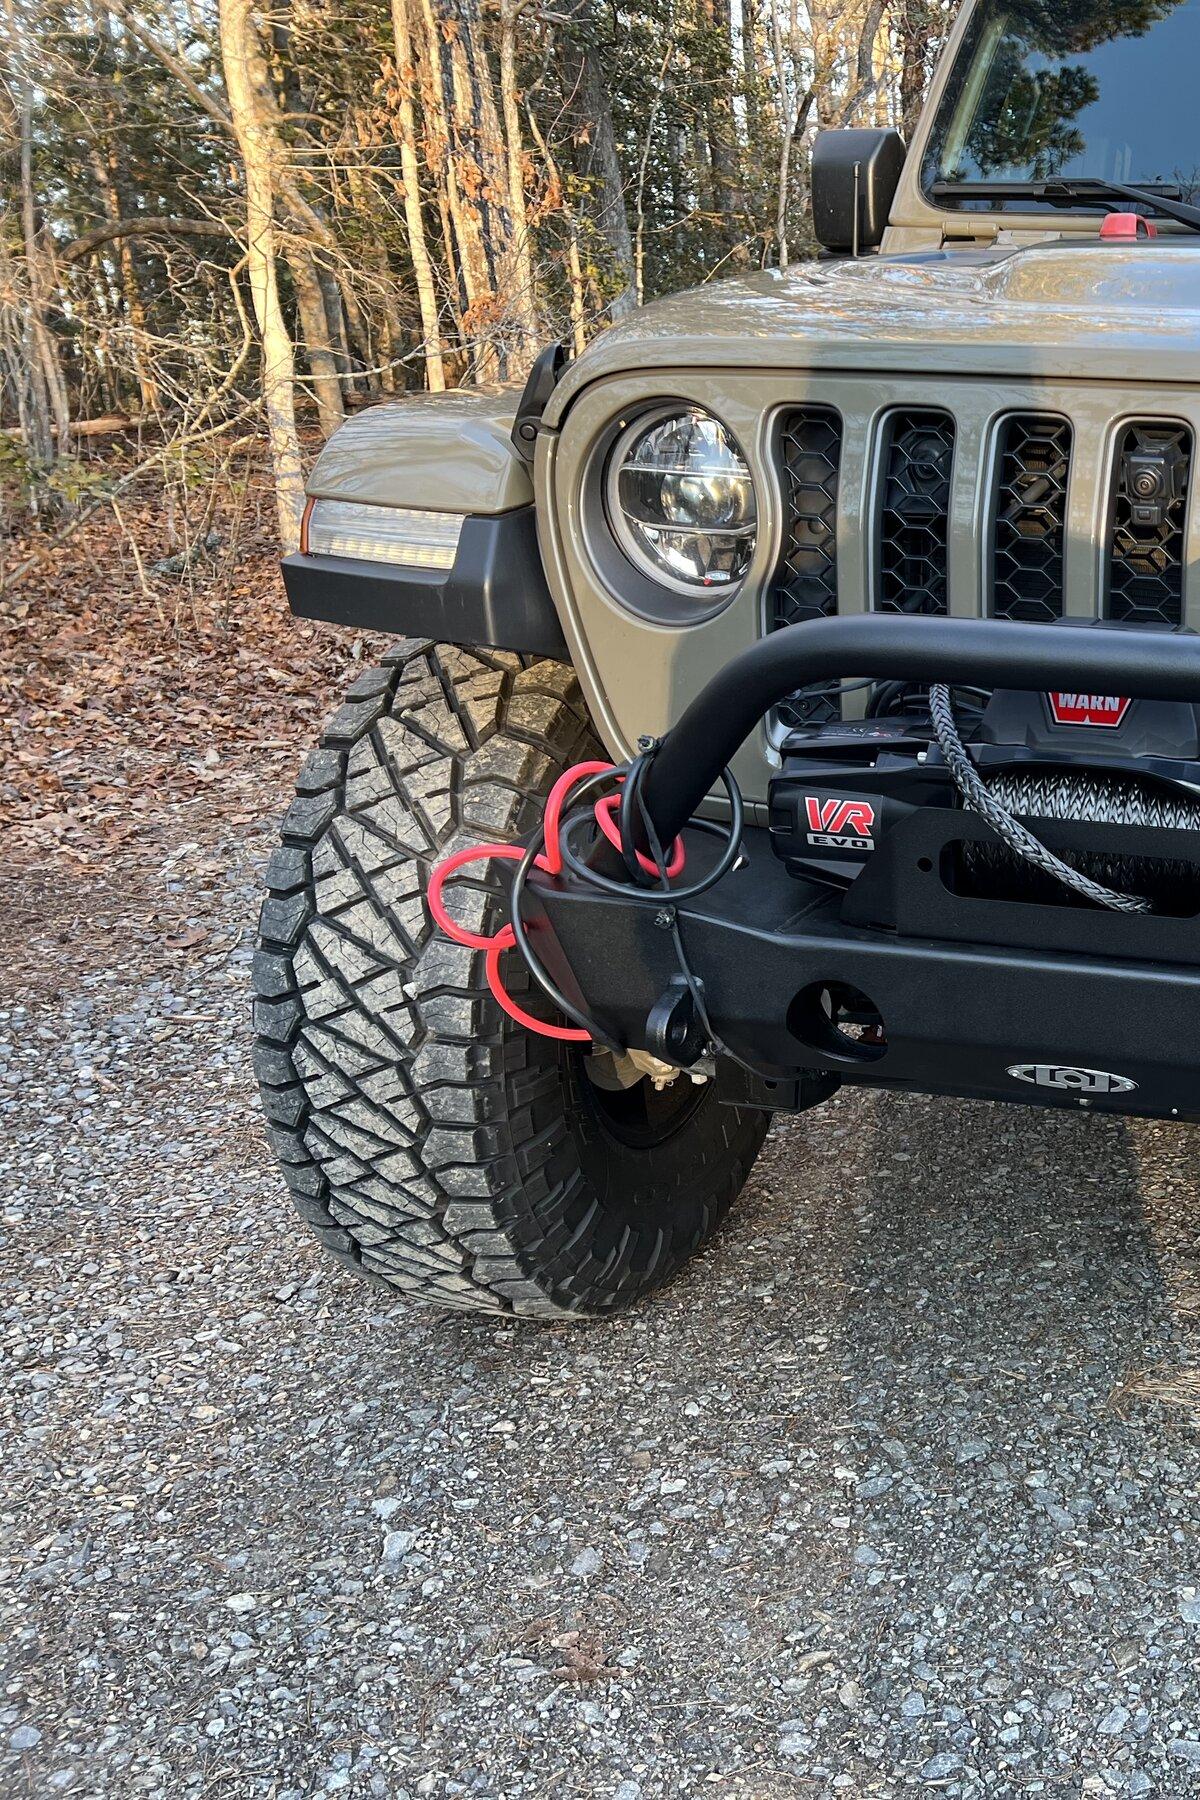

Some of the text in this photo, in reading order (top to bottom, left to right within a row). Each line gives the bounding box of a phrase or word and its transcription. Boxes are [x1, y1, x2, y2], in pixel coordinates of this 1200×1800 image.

[1058, 693, 1119, 711] WARN
[804, 796, 875, 836] VR
[812, 835, 869, 848] EVO
